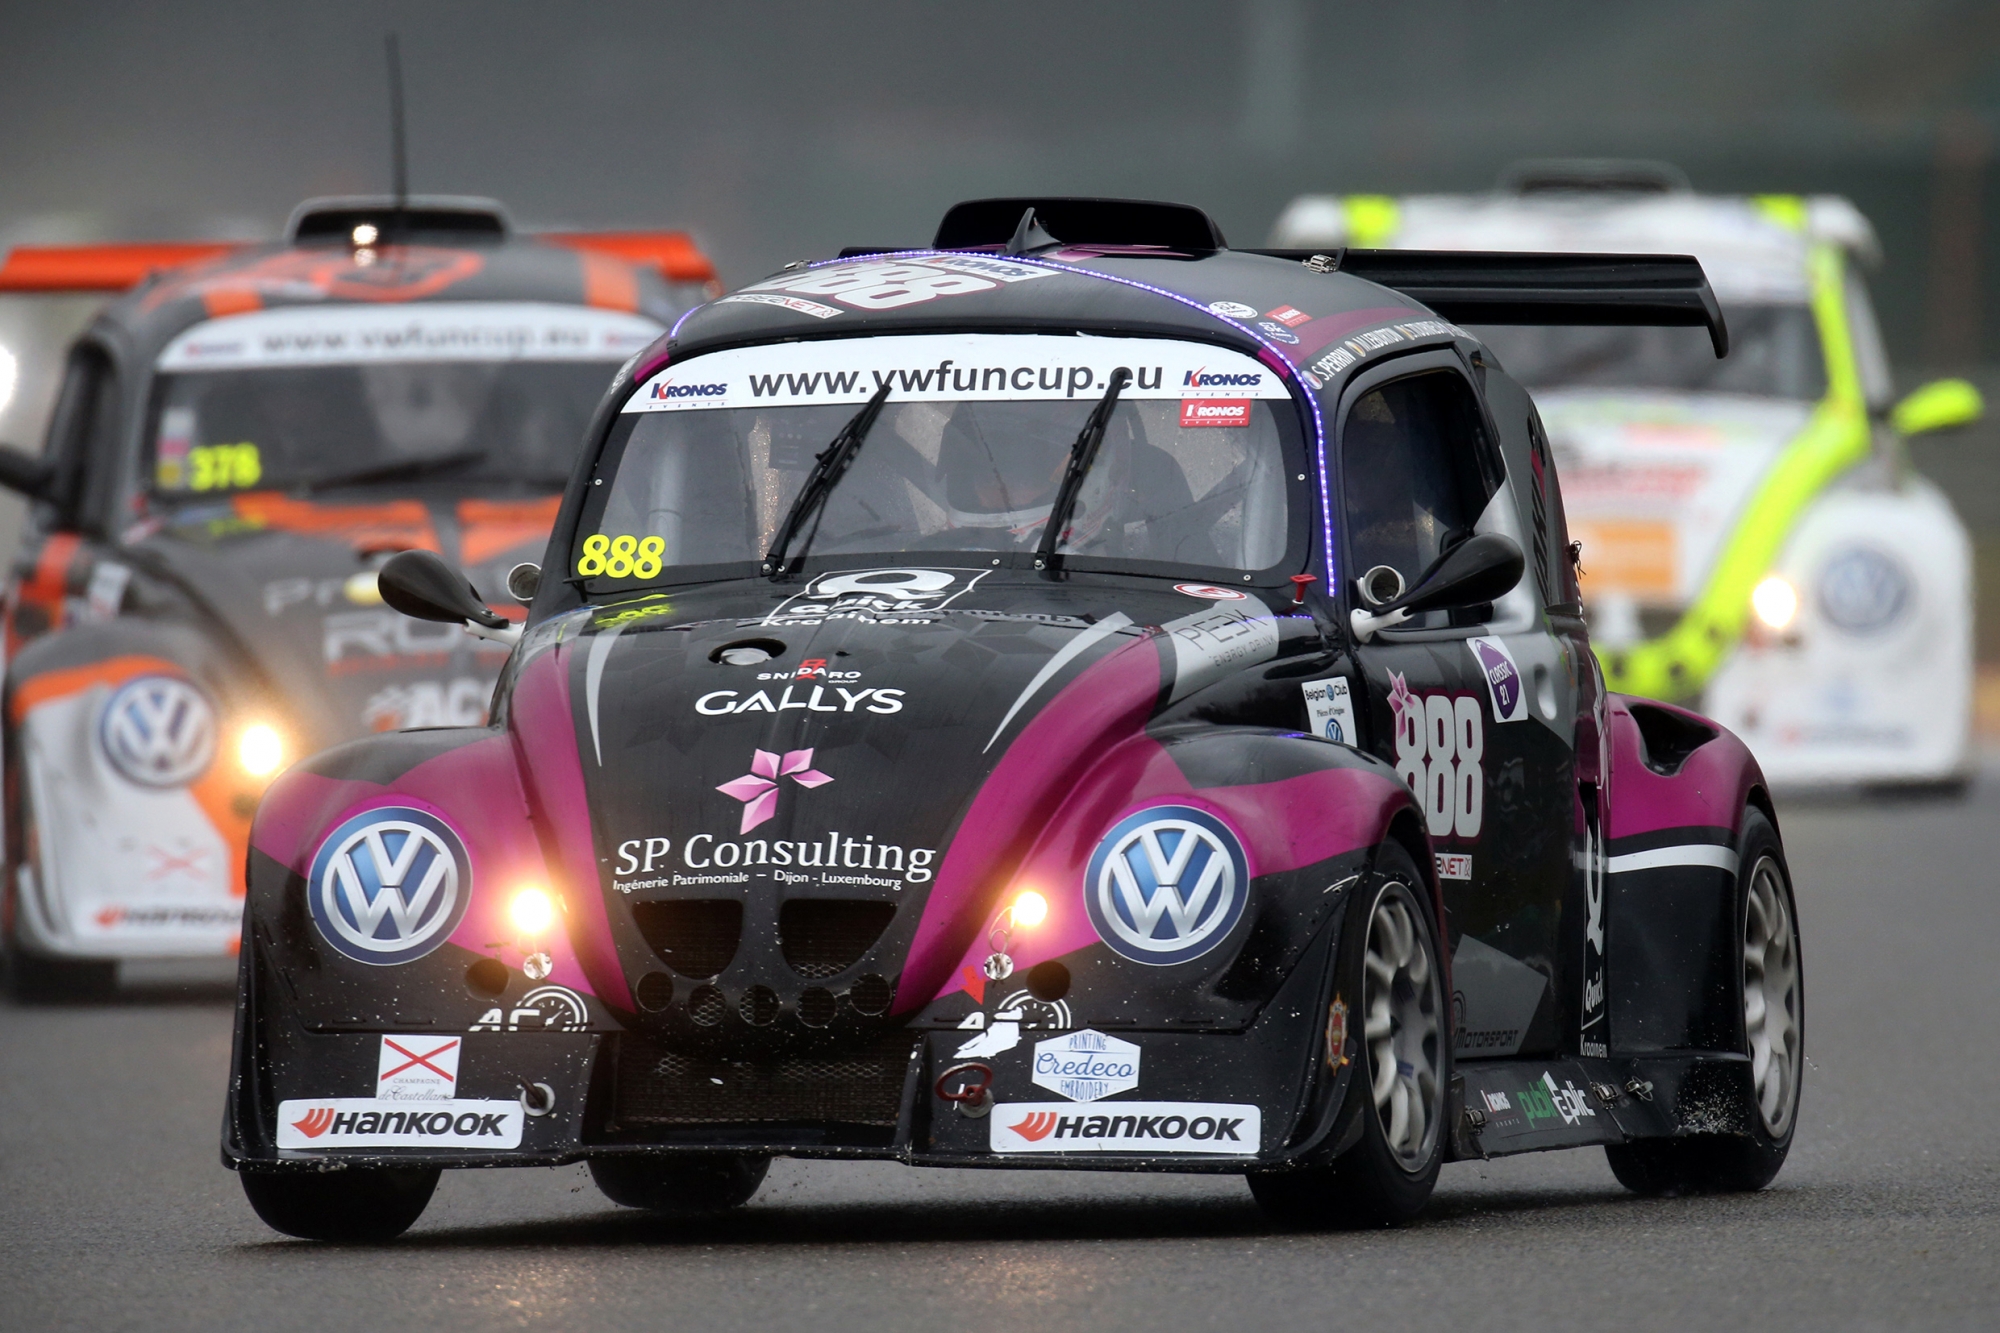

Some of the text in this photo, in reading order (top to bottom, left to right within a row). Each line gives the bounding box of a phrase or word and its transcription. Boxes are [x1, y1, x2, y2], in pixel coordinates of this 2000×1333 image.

[748, 359, 1163, 399] www.vwfuncup.eu
[1183, 366, 1262, 387] KRONOS
[651, 378, 728, 399] KRONOS
[1186, 401, 1245, 418] KRONOS
[577, 534, 666, 580] 888
[789, 596, 927, 613] Quick
[1252, 634, 1277, 652] DRINK
[756, 667, 862, 681] SNIDARO
[1489, 660, 1513, 685] CLASSIC
[695, 685, 906, 716] GALLYS
[1499, 685, 1510, 706] 21
[1395, 694, 1483, 838] 888
[684, 832, 936, 884] Consulting
[613, 870, 902, 894] Ingénerie Patrimoniale Dijon Luxembourg
[1069, 1033, 1107, 1050] PRINTING
[1036, 1053, 1136, 1078] Credeco
[393, 1077, 441, 1086] CHAMPAGNE
[1060, 1081, 1109, 1101] EMBROIDERY
